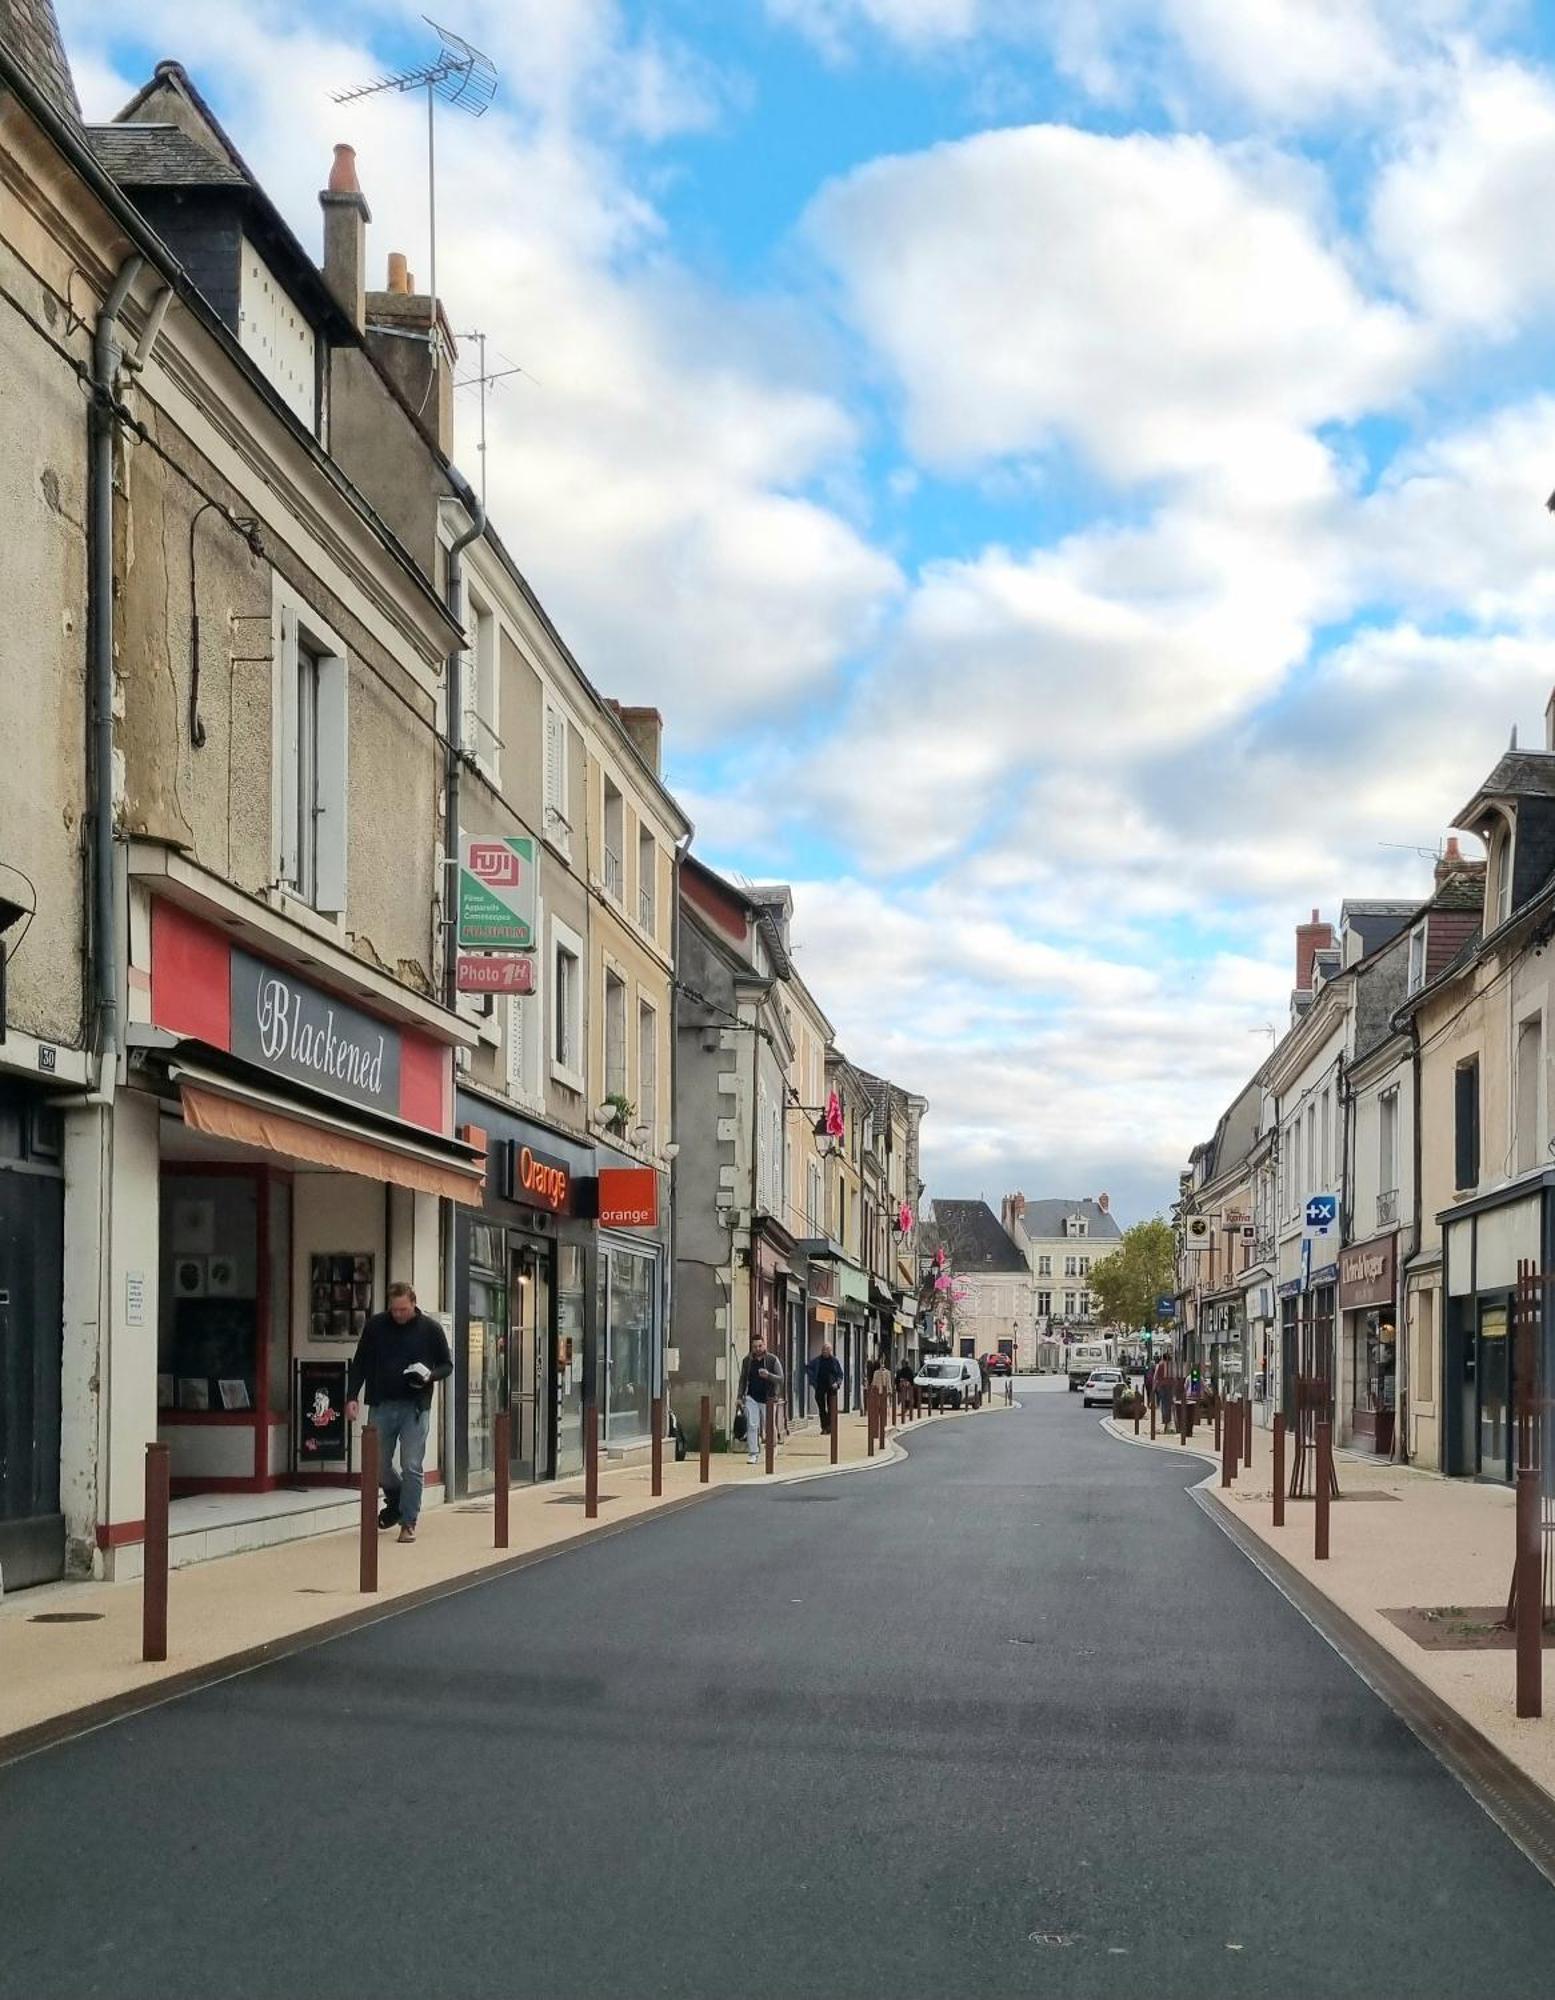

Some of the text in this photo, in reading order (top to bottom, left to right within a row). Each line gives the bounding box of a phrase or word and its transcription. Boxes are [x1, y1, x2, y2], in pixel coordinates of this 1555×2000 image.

[470, 848, 514, 881] FUJI
[459, 965, 499, 982] Photo
[256, 970, 384, 1094] Blackened
[44, 1050, 54, 1067] 30
[520, 1147, 566, 1208] Orange
[601, 1210, 649, 1223] orange
